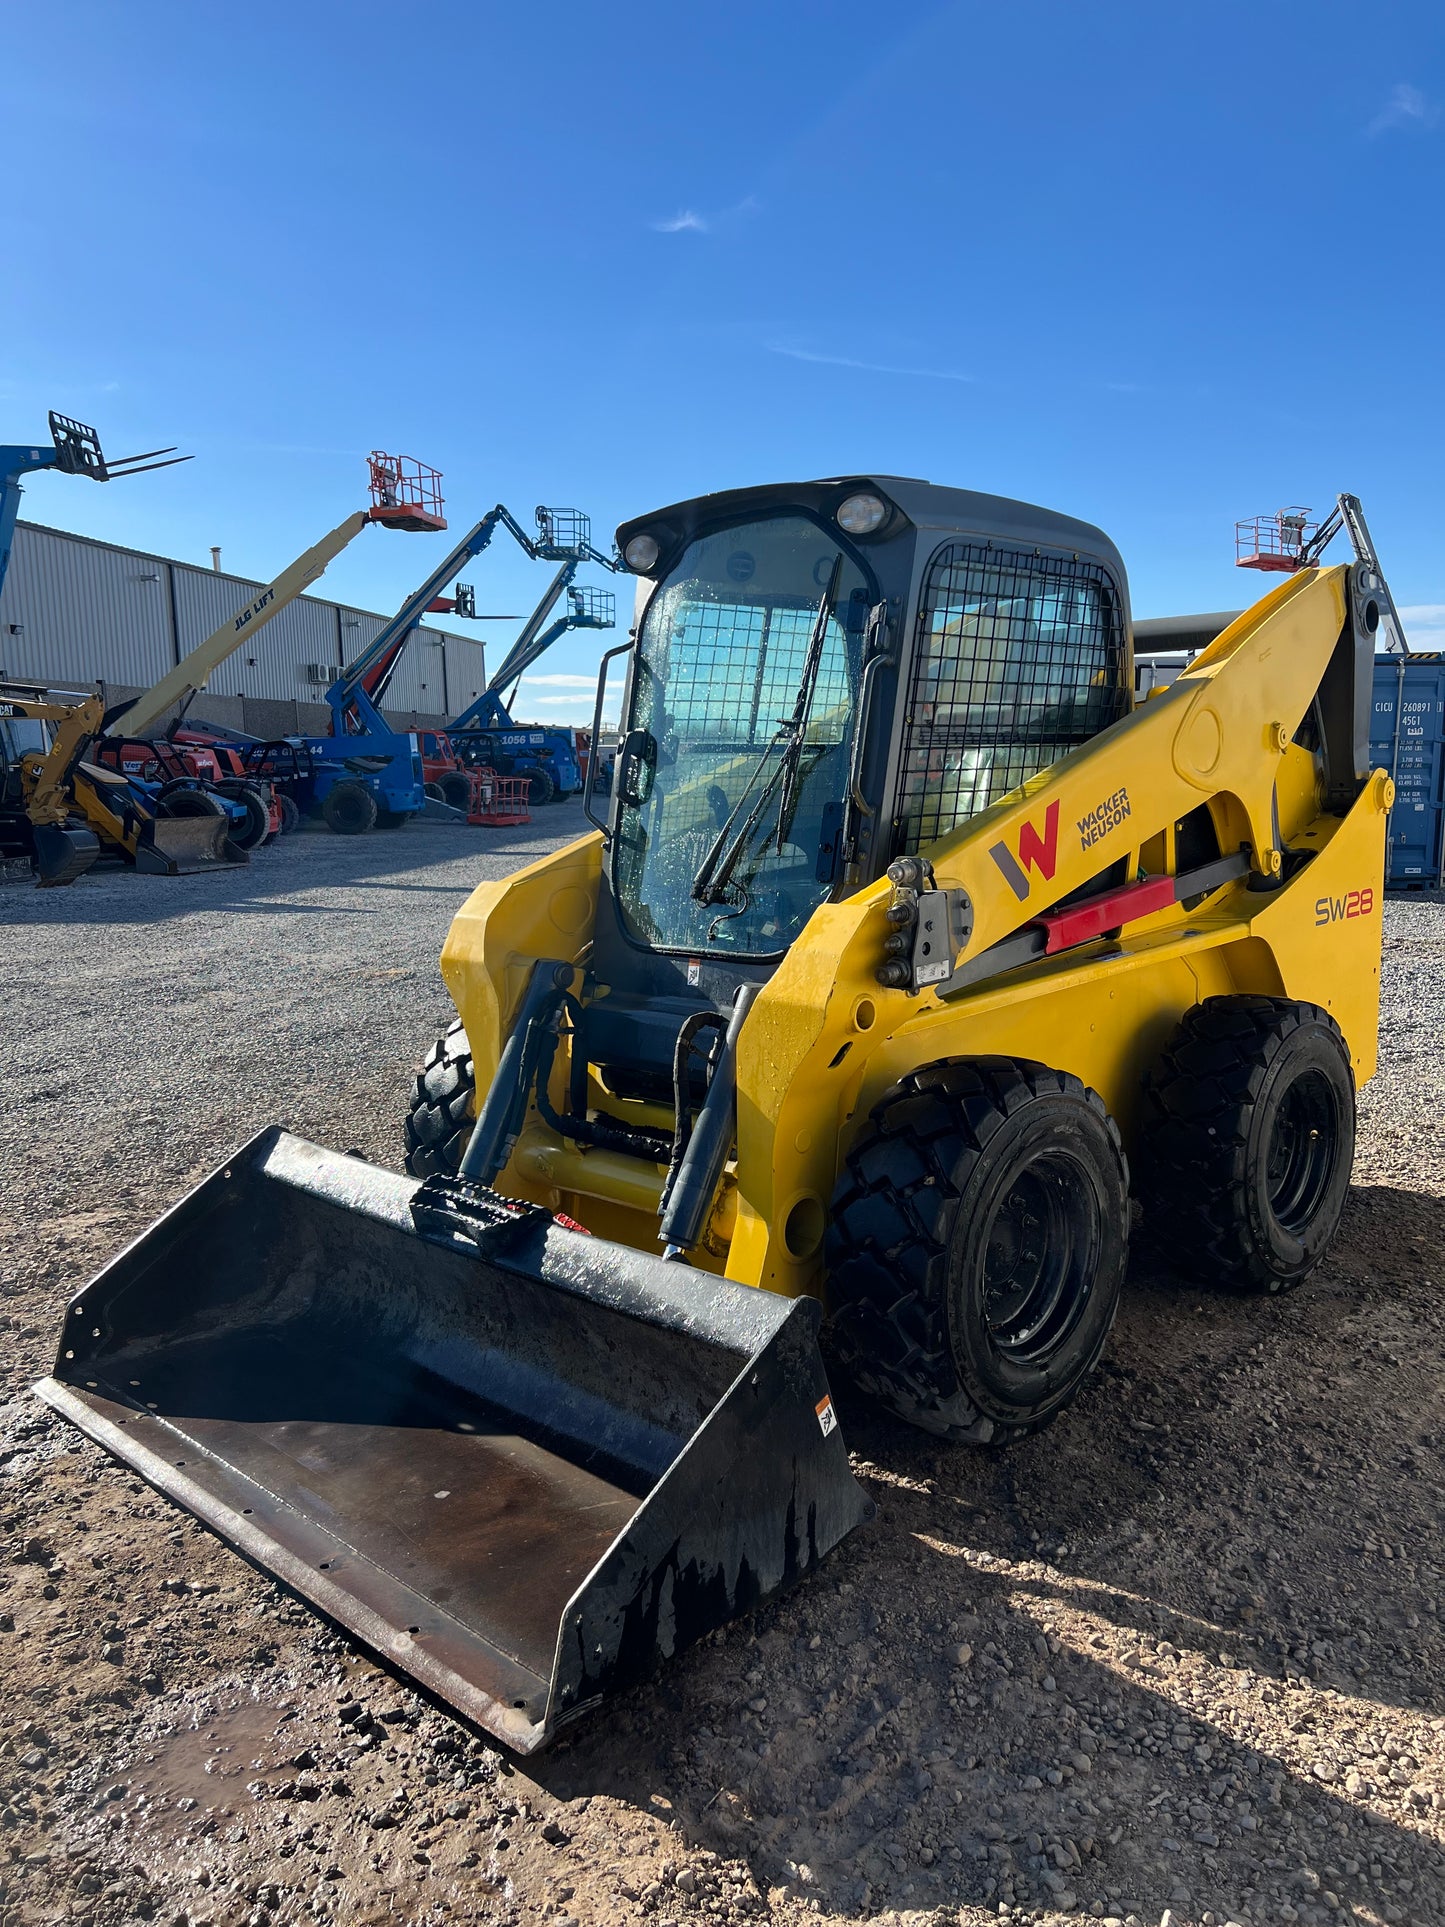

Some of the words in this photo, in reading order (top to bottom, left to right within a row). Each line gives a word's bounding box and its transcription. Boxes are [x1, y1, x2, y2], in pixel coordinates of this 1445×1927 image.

[235, 609, 252, 631] JLG
[253, 588, 275, 614] LIFT
[0, 704, 14, 716] CAT
[1375, 702, 1393, 712] CICU
[1403, 702, 1431, 712] 260891
[1402, 715, 1420, 726] 45G1
[1076, 787, 1129, 834] WACKER
[1080, 801, 1132, 852] NEUSON
[1315, 888, 1374, 926] SW28
